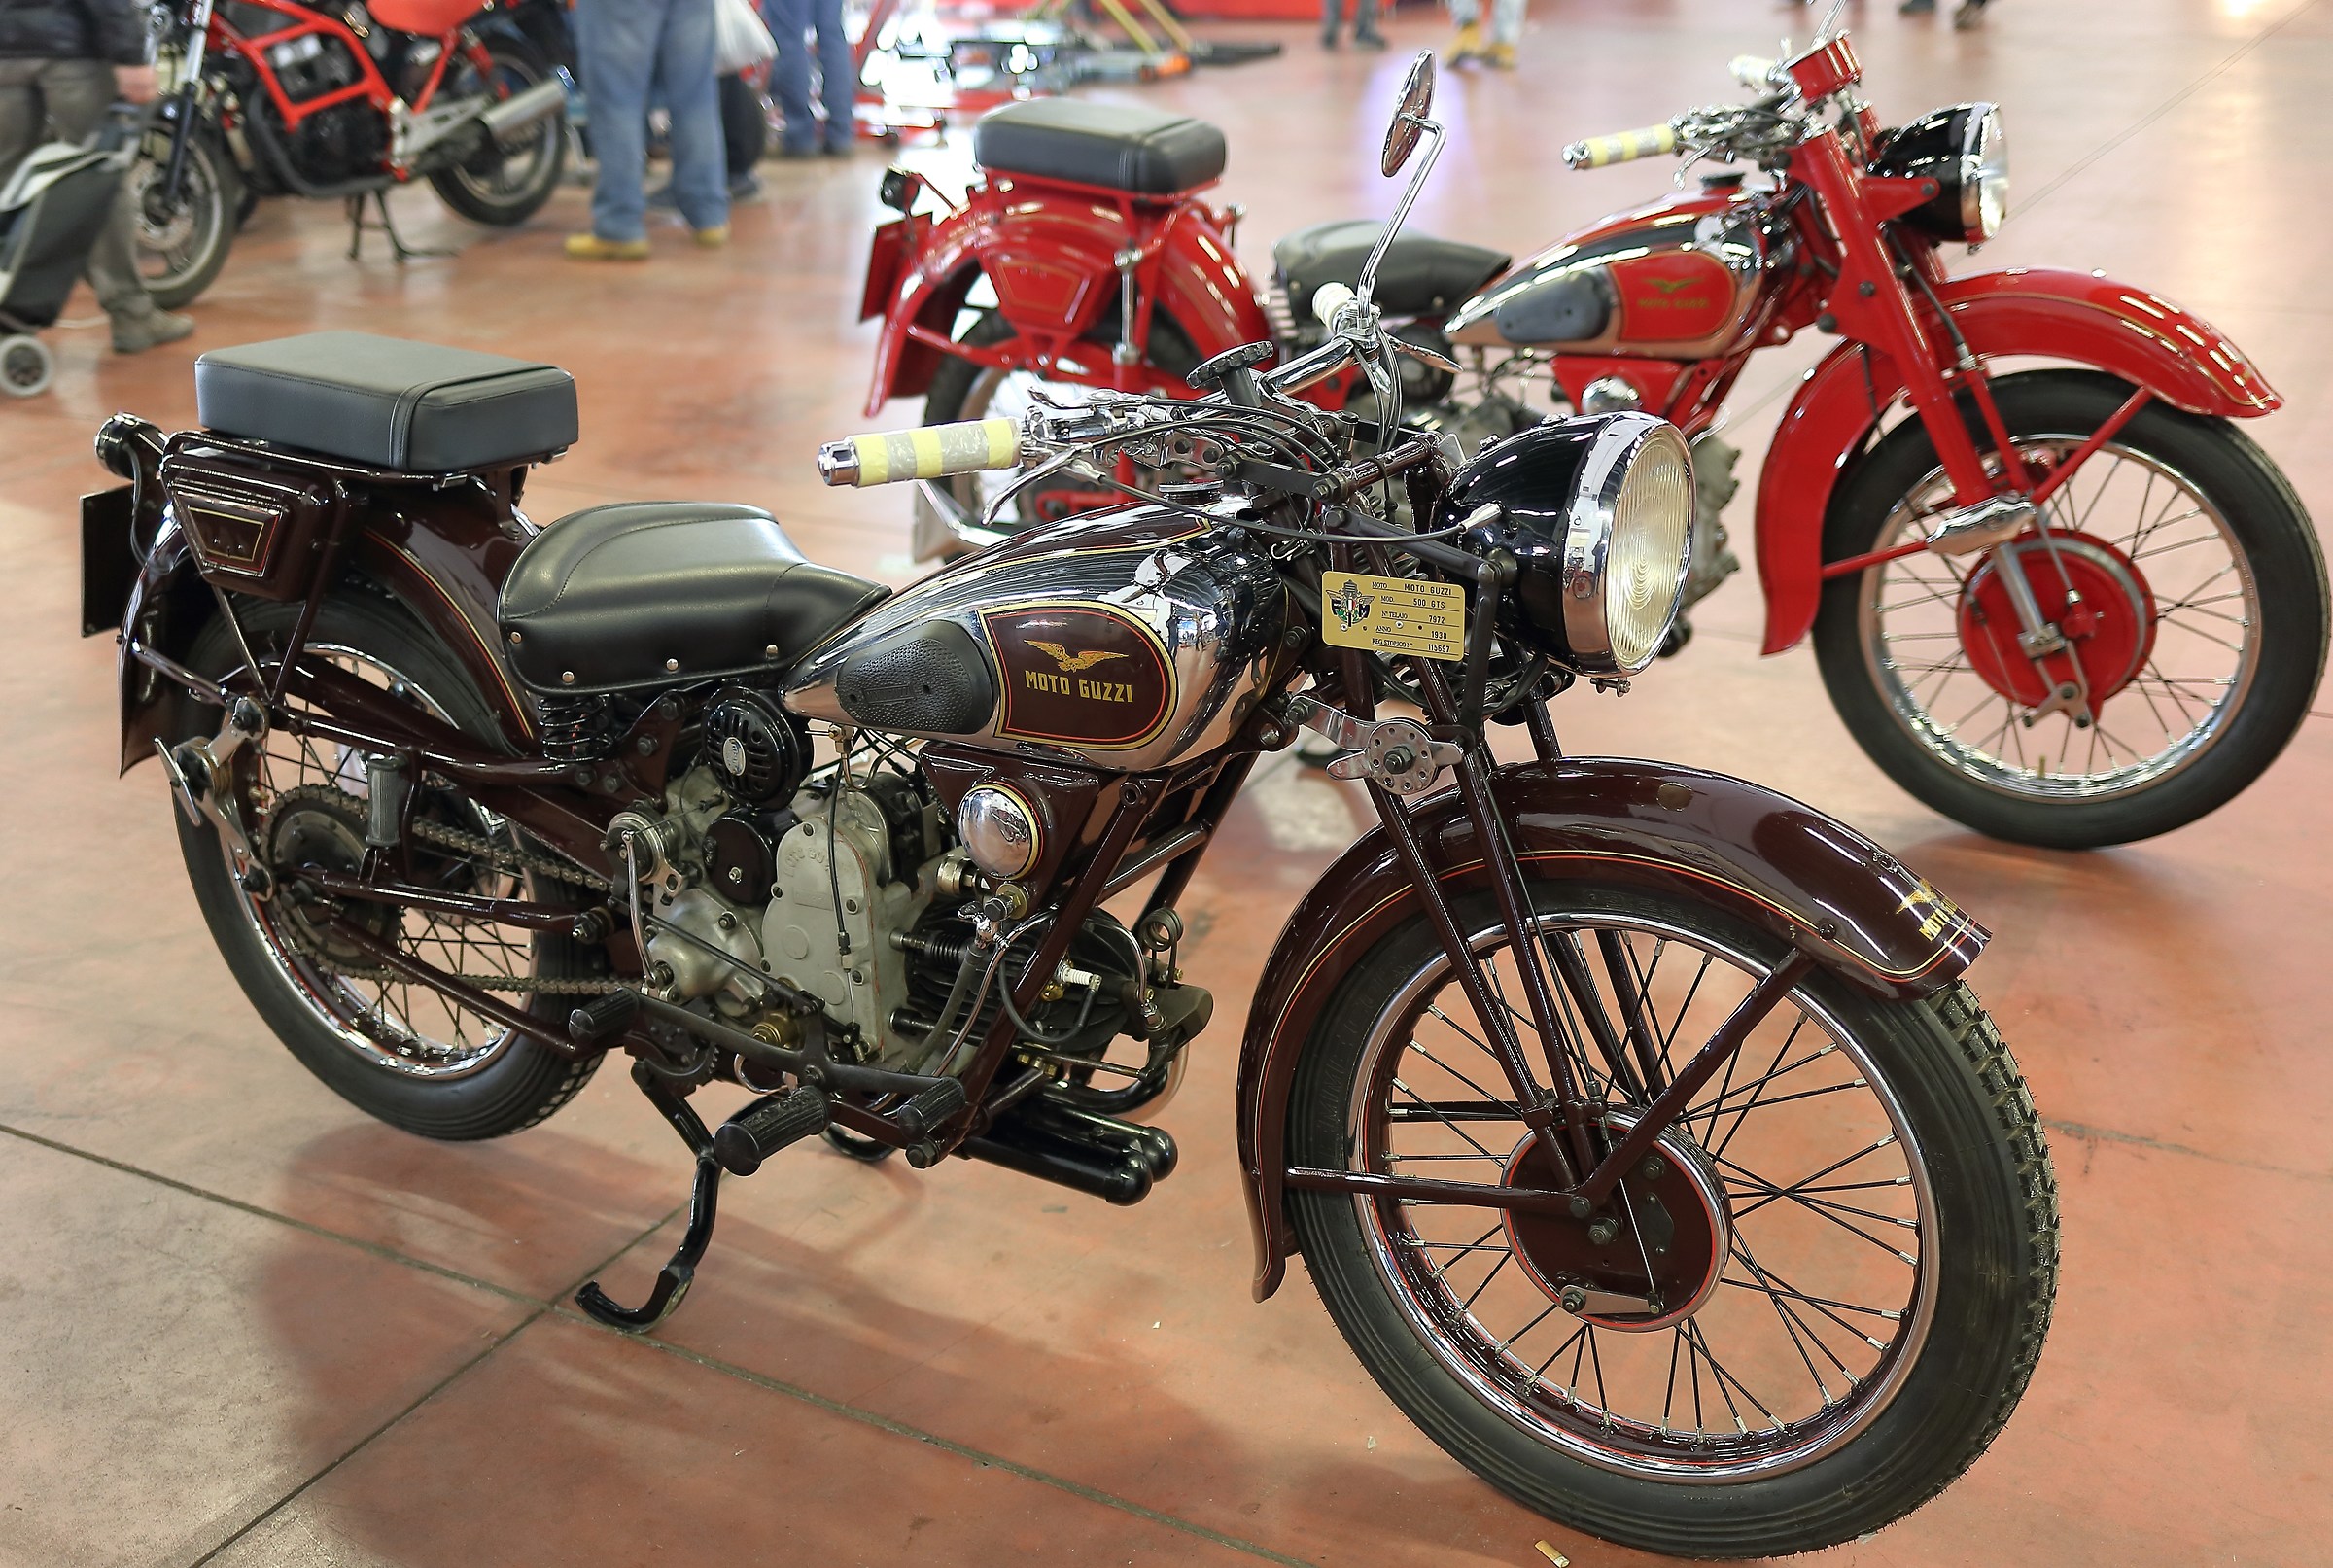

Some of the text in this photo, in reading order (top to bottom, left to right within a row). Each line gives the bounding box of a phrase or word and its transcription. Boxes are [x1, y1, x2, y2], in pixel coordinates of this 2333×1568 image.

[1404, 583, 1425, 592] MOTO
[1431, 600, 1445, 609] GTS
[1429, 615, 1445, 624] 7972
[1428, 644, 1450, 652] 115697
[1025, 670, 1132, 703] MOTO GUZZI
[1919, 908, 1950, 941] MOTO
